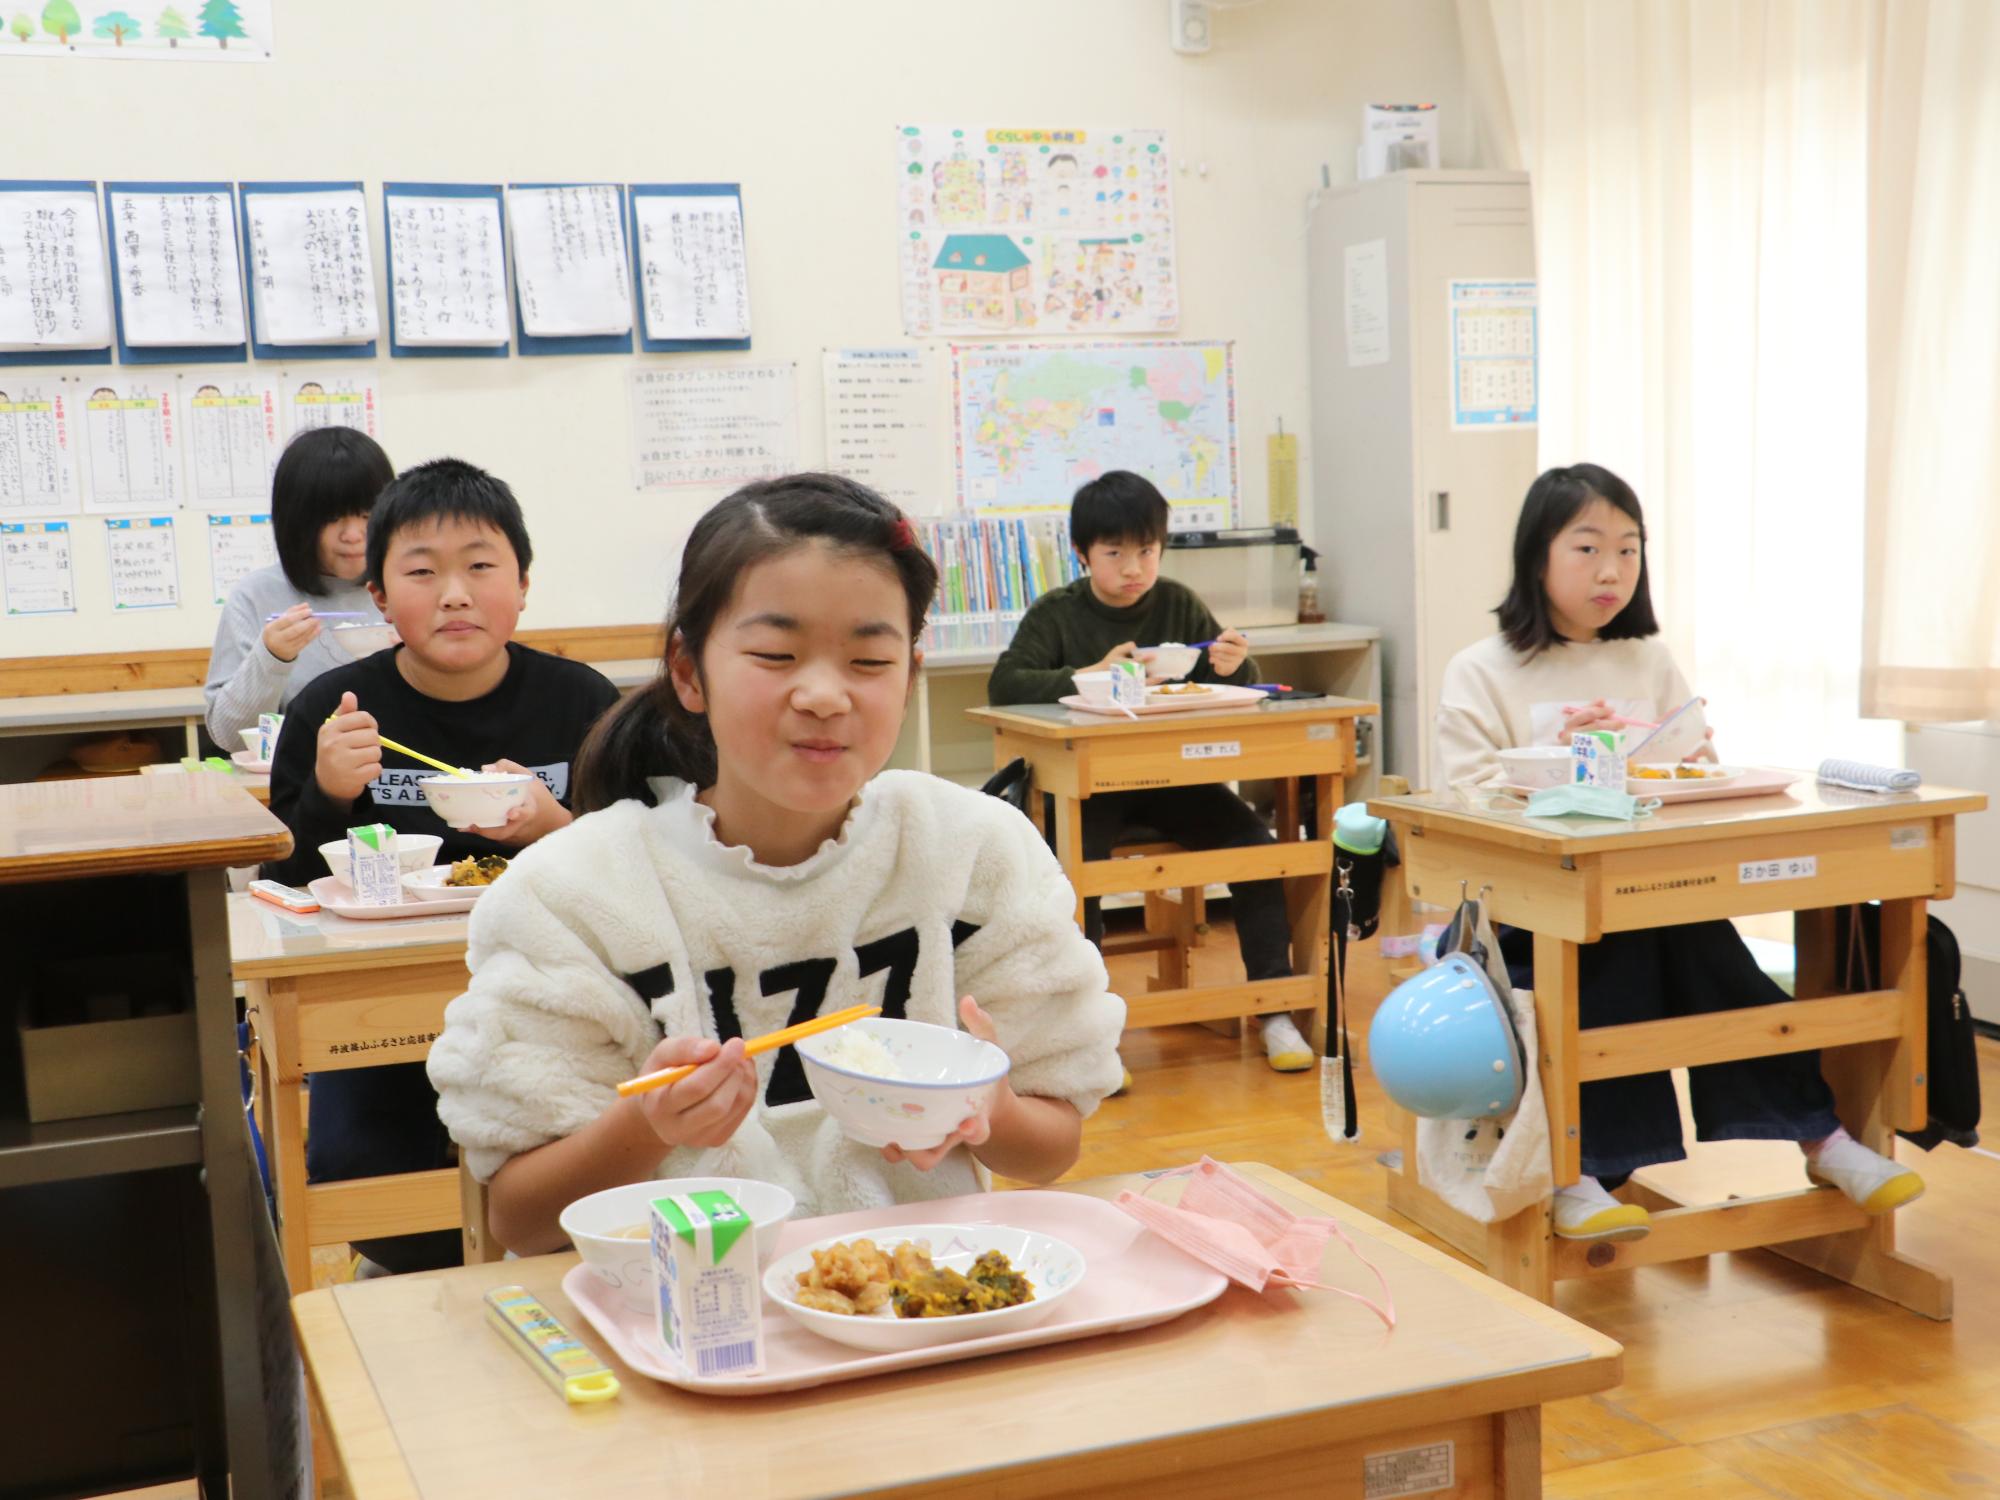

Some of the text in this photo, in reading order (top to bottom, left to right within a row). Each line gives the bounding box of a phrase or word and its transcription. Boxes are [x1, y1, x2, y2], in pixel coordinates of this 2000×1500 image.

[365, 387, 375, 437] 2学期のめあ
[398, 789, 410, 801] A
[1788, 861, 1813, 874] ゆい
[329, 1032, 441, 1055] 丹波篠山ふるさと応援寄
